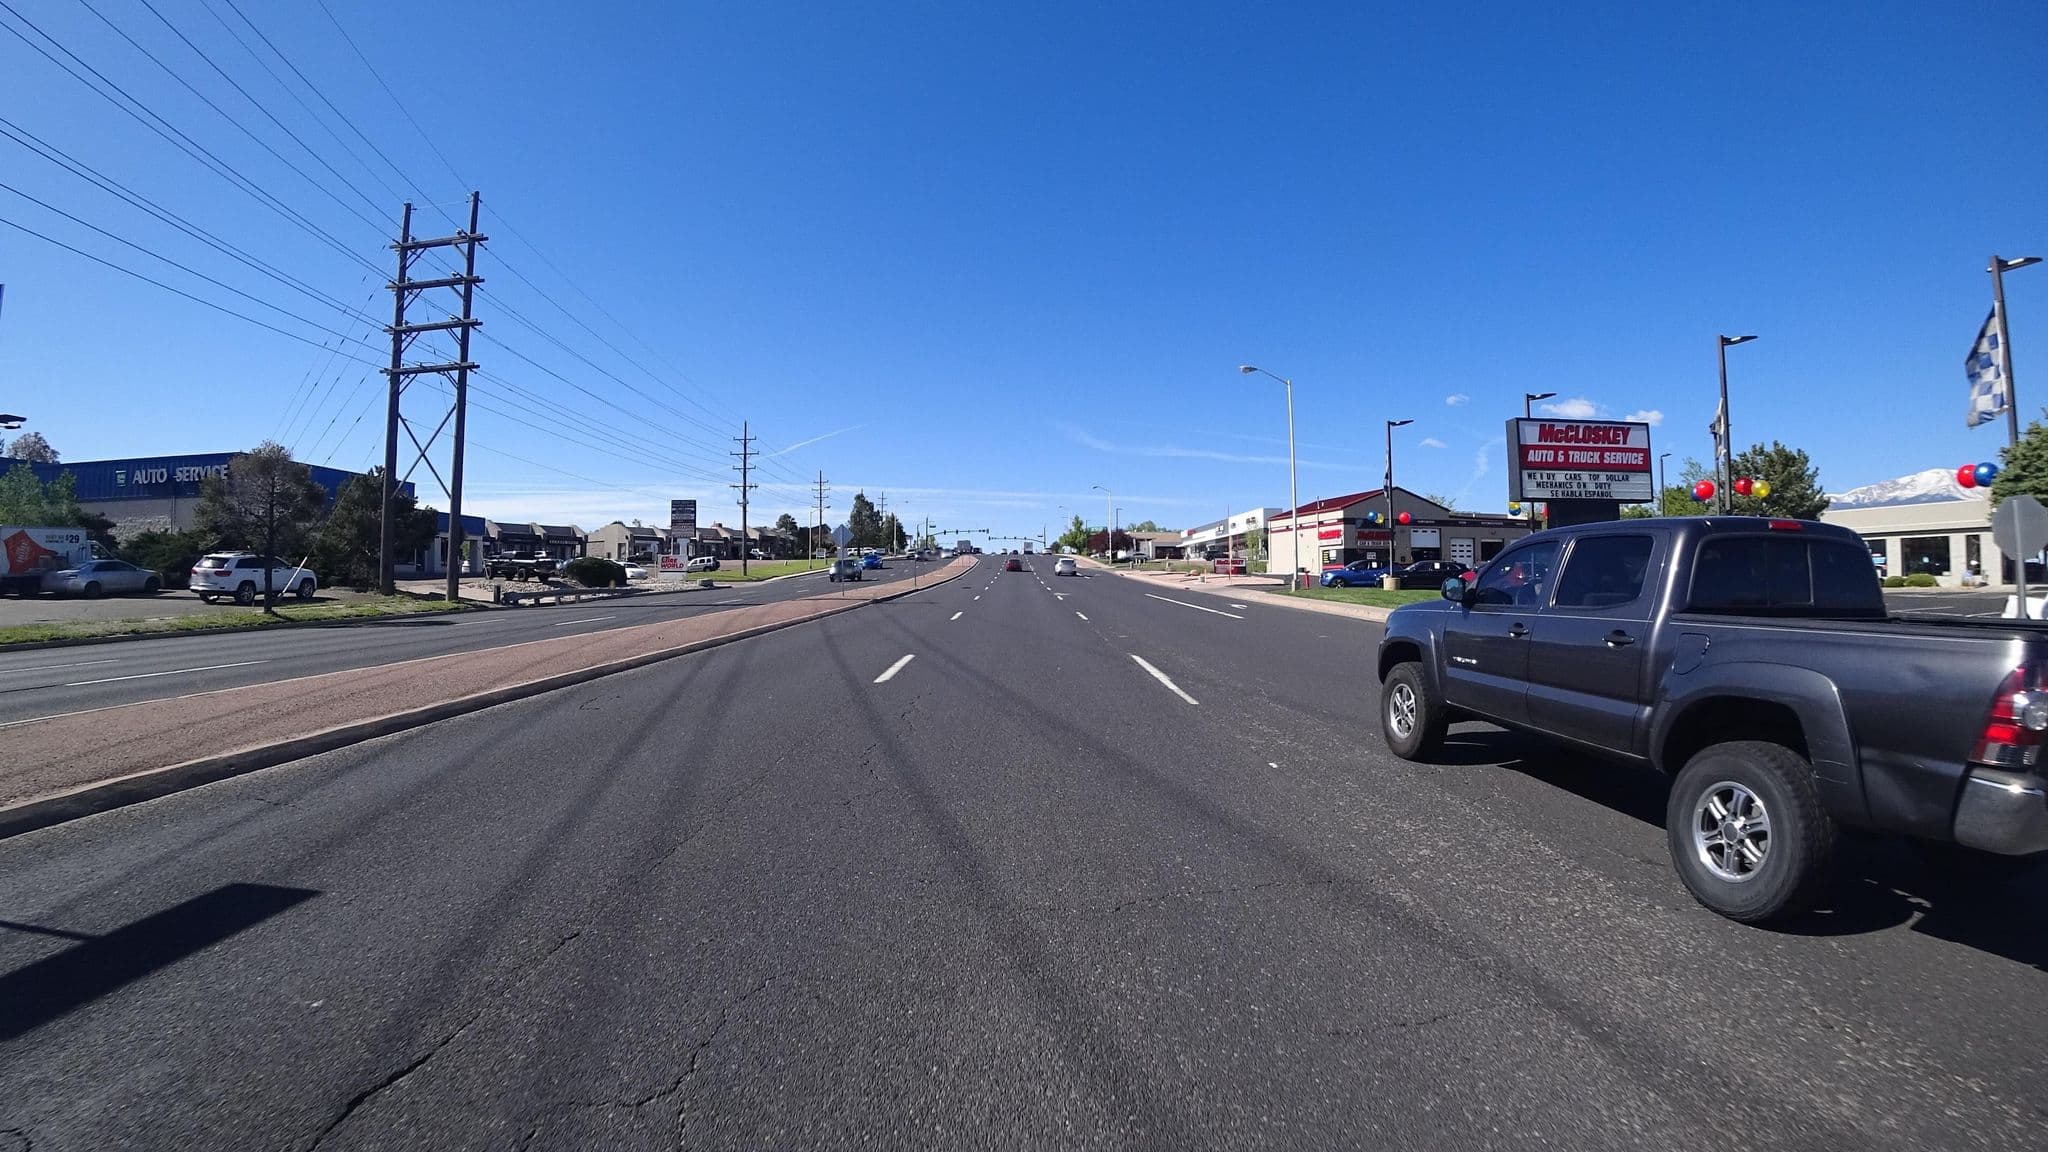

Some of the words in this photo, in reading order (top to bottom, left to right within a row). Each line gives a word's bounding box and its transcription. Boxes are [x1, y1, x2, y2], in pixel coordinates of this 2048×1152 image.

[1537, 424, 1632, 445] McCLOSKEY
[1527, 449, 1554, 462] AUTO
[1568, 451, 1600, 464] TRUCK
[1603, 452, 1644, 465] SERVICE
[132, 468, 168, 484] AUTO
[175, 464, 229, 483] SERVICE
[1526, 472, 1537, 480] WE
[1564, 473, 1582, 481] CARS
[1589, 473, 1600, 481] TOP
[1606, 474, 1630, 482] DOLLAR
[1536, 481, 1573, 489] MECHANICS
[1550, 489, 1559, 497] SE
